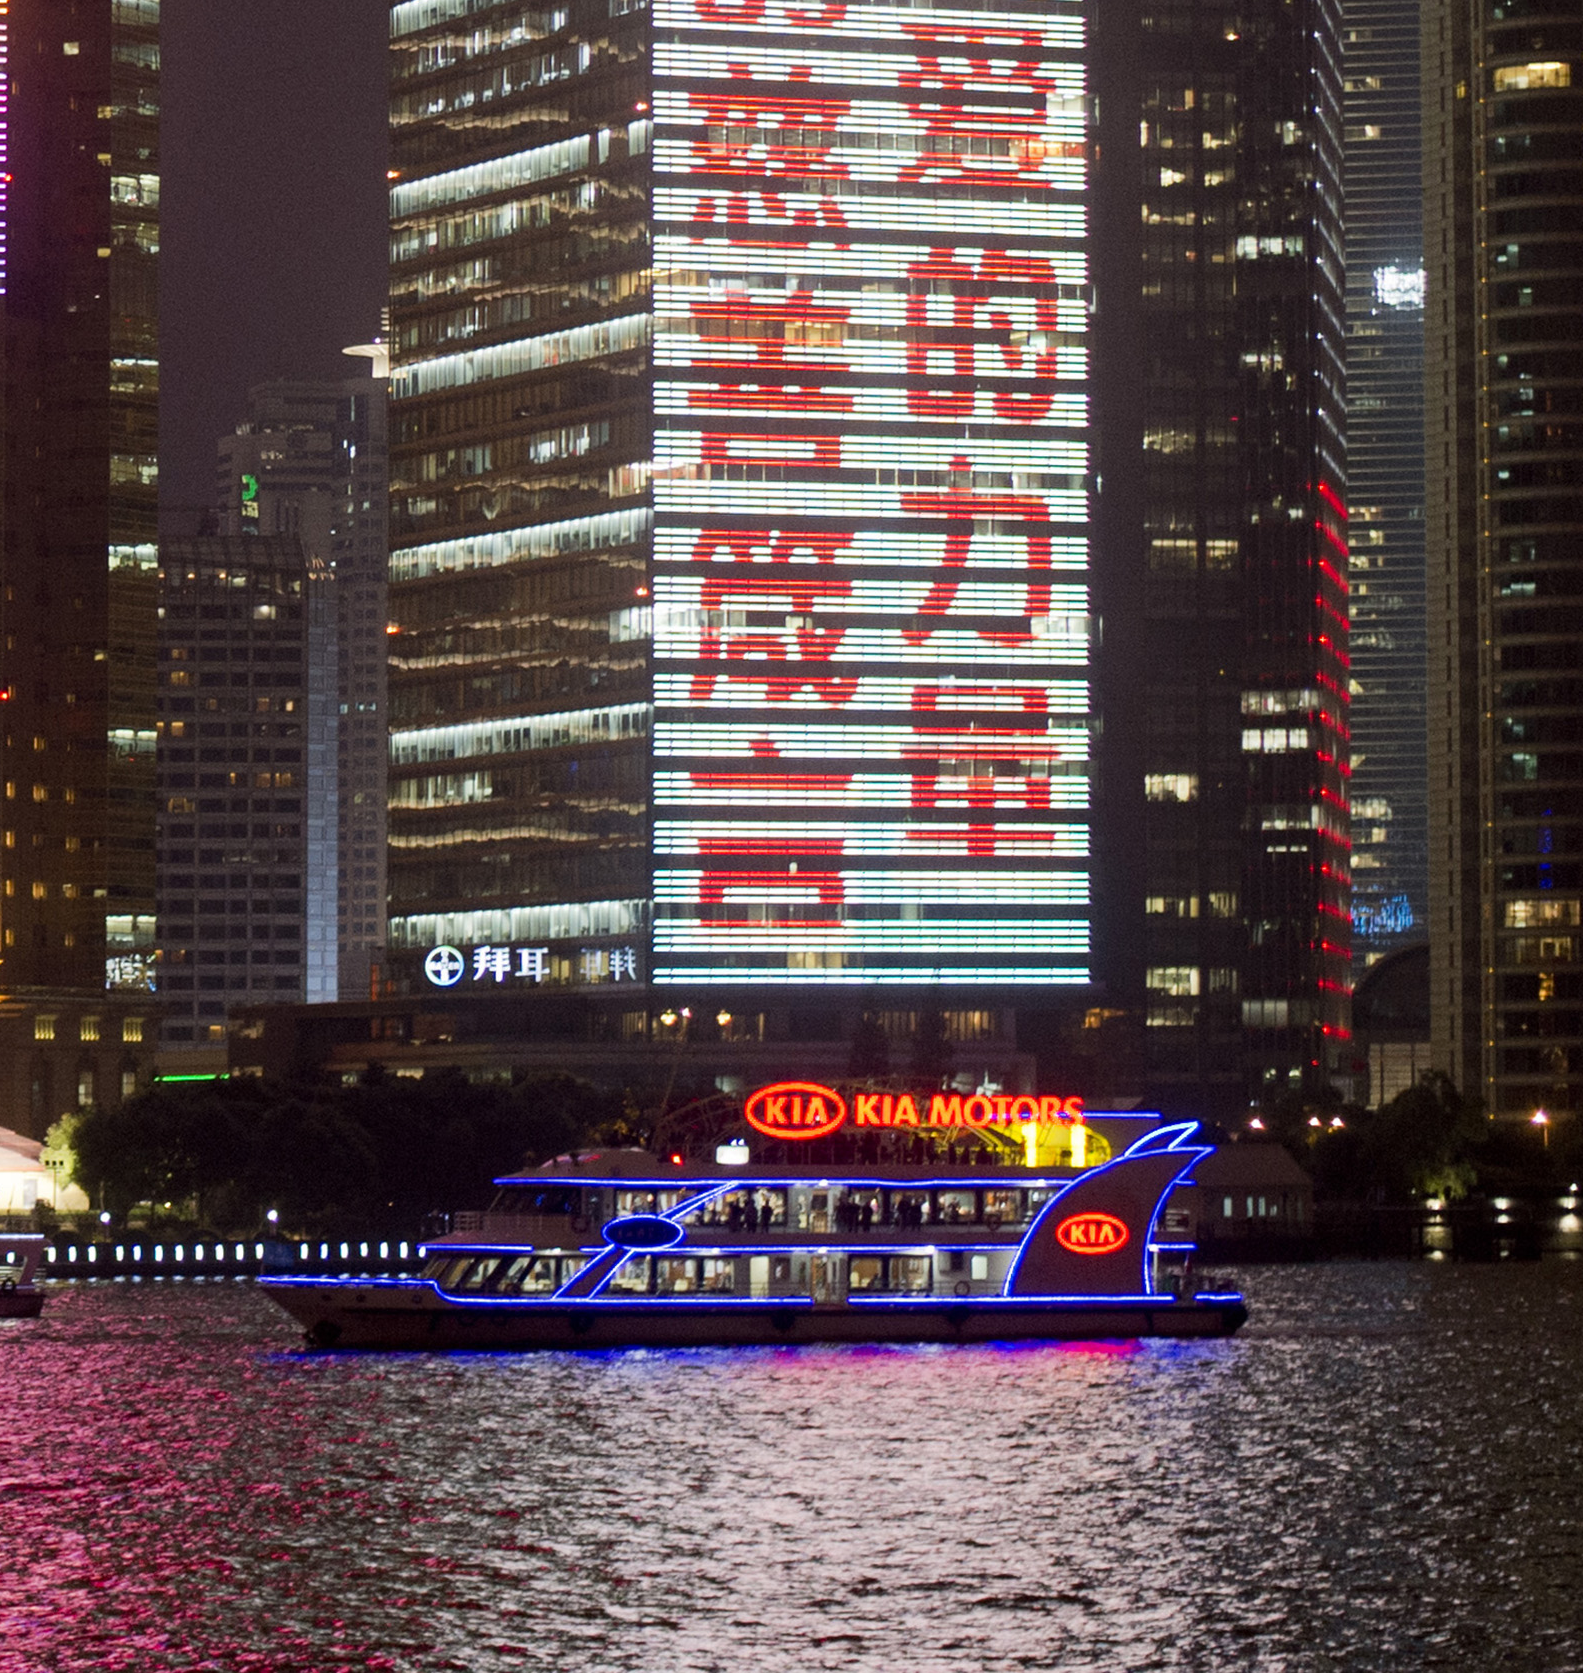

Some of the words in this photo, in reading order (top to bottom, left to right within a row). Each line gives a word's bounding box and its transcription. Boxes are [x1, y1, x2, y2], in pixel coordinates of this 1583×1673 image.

[472, 945, 550, 983] 拜耳
[764, 1094, 828, 1125] KIA
[855, 1094, 920, 1126] KIA
[929, 1093, 1085, 1127] MOTORS
[1070, 1222, 1116, 1244] KIA
